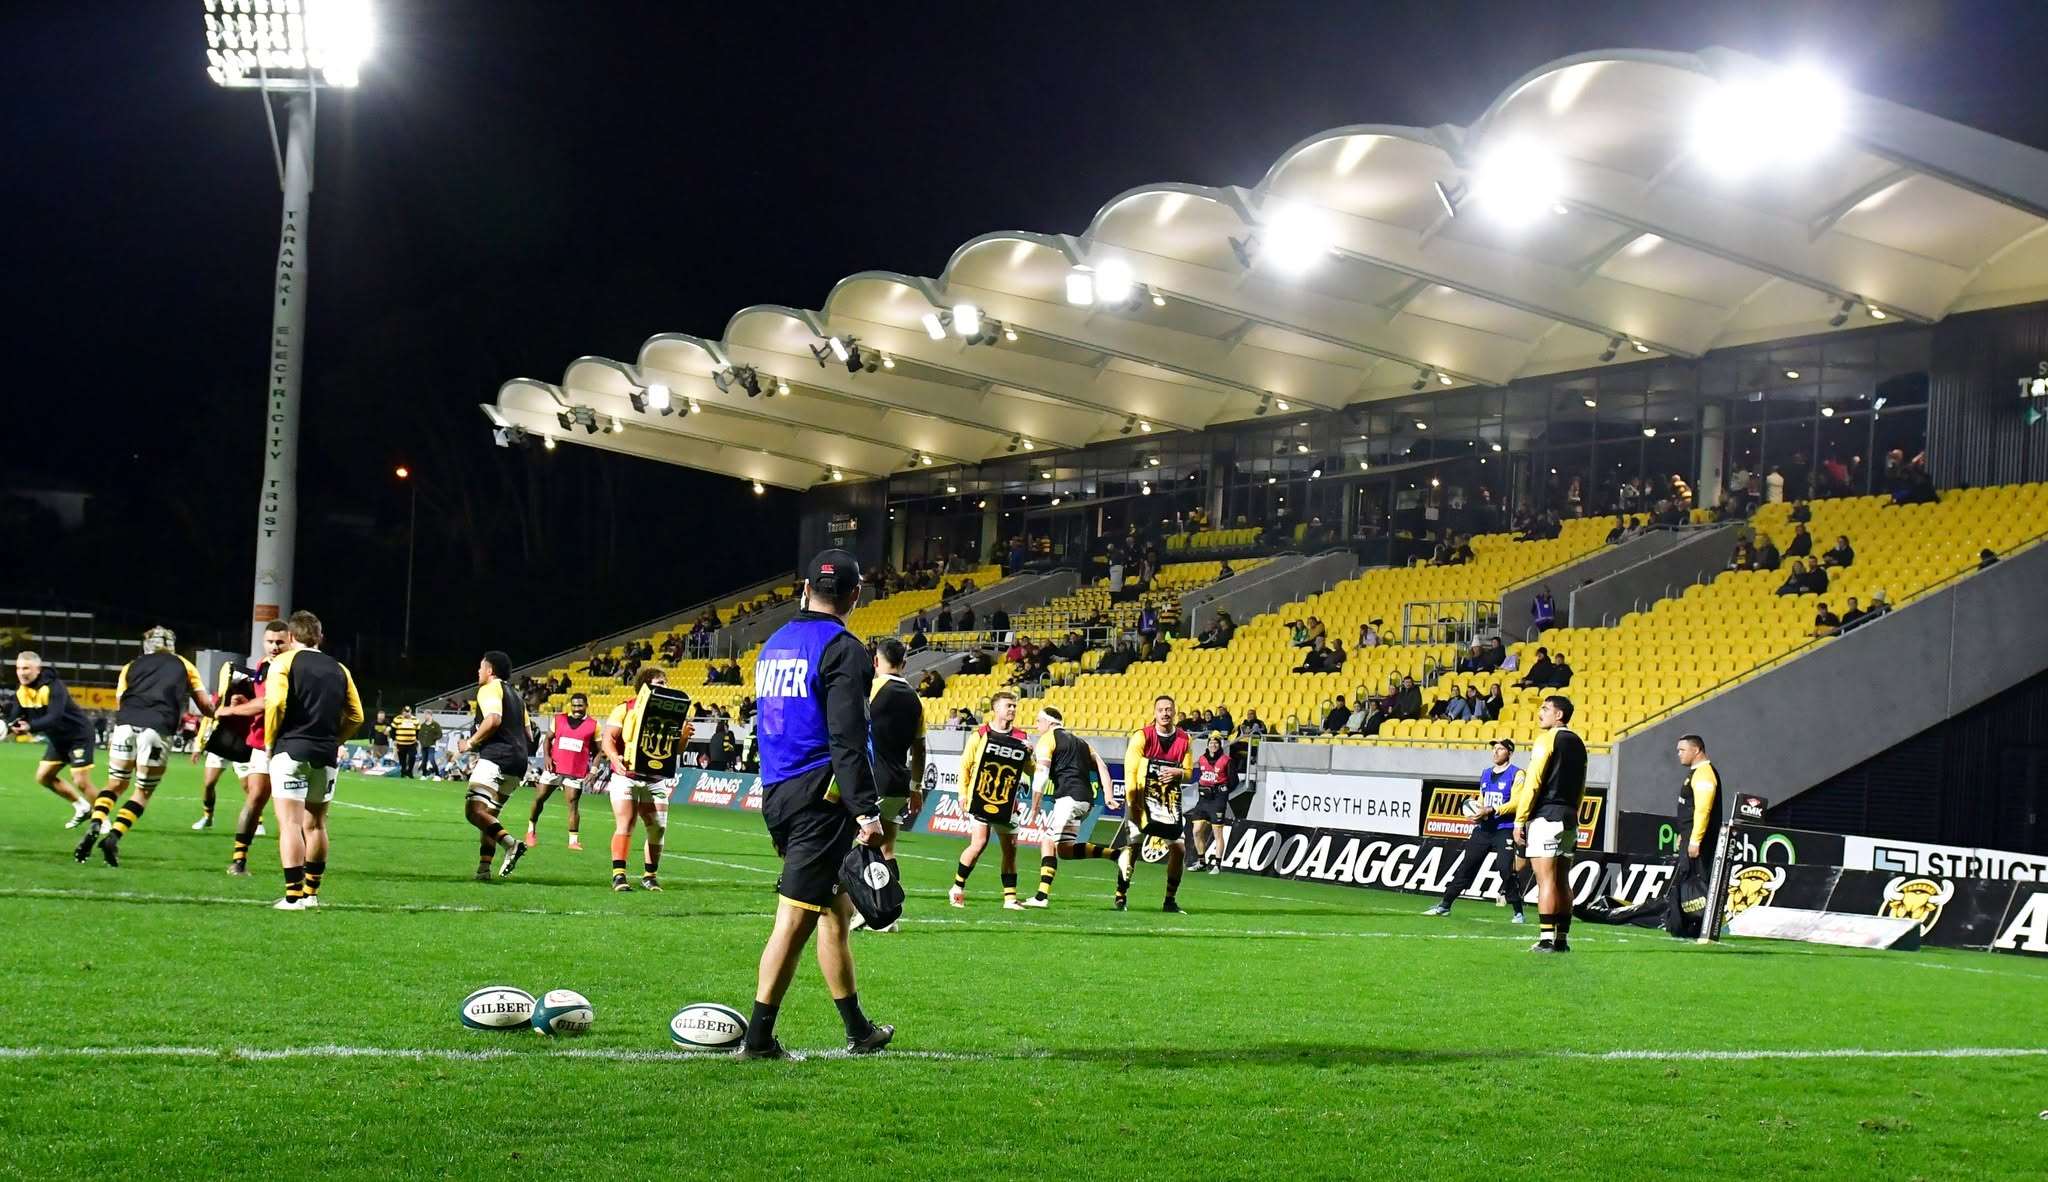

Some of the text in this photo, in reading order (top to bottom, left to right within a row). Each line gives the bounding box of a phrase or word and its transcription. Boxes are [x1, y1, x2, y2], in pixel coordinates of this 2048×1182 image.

[264, 211, 297, 538] TARANAKI ELECTRICITY TRUST
[756, 658, 808, 698] WATER
[1291, 794, 1412, 819] FORSYTH BARR
[1740, 804, 1763, 817] CMK
[471, 1002, 532, 1015] GILBERT
[675, 1018, 736, 1034] GILBERT
